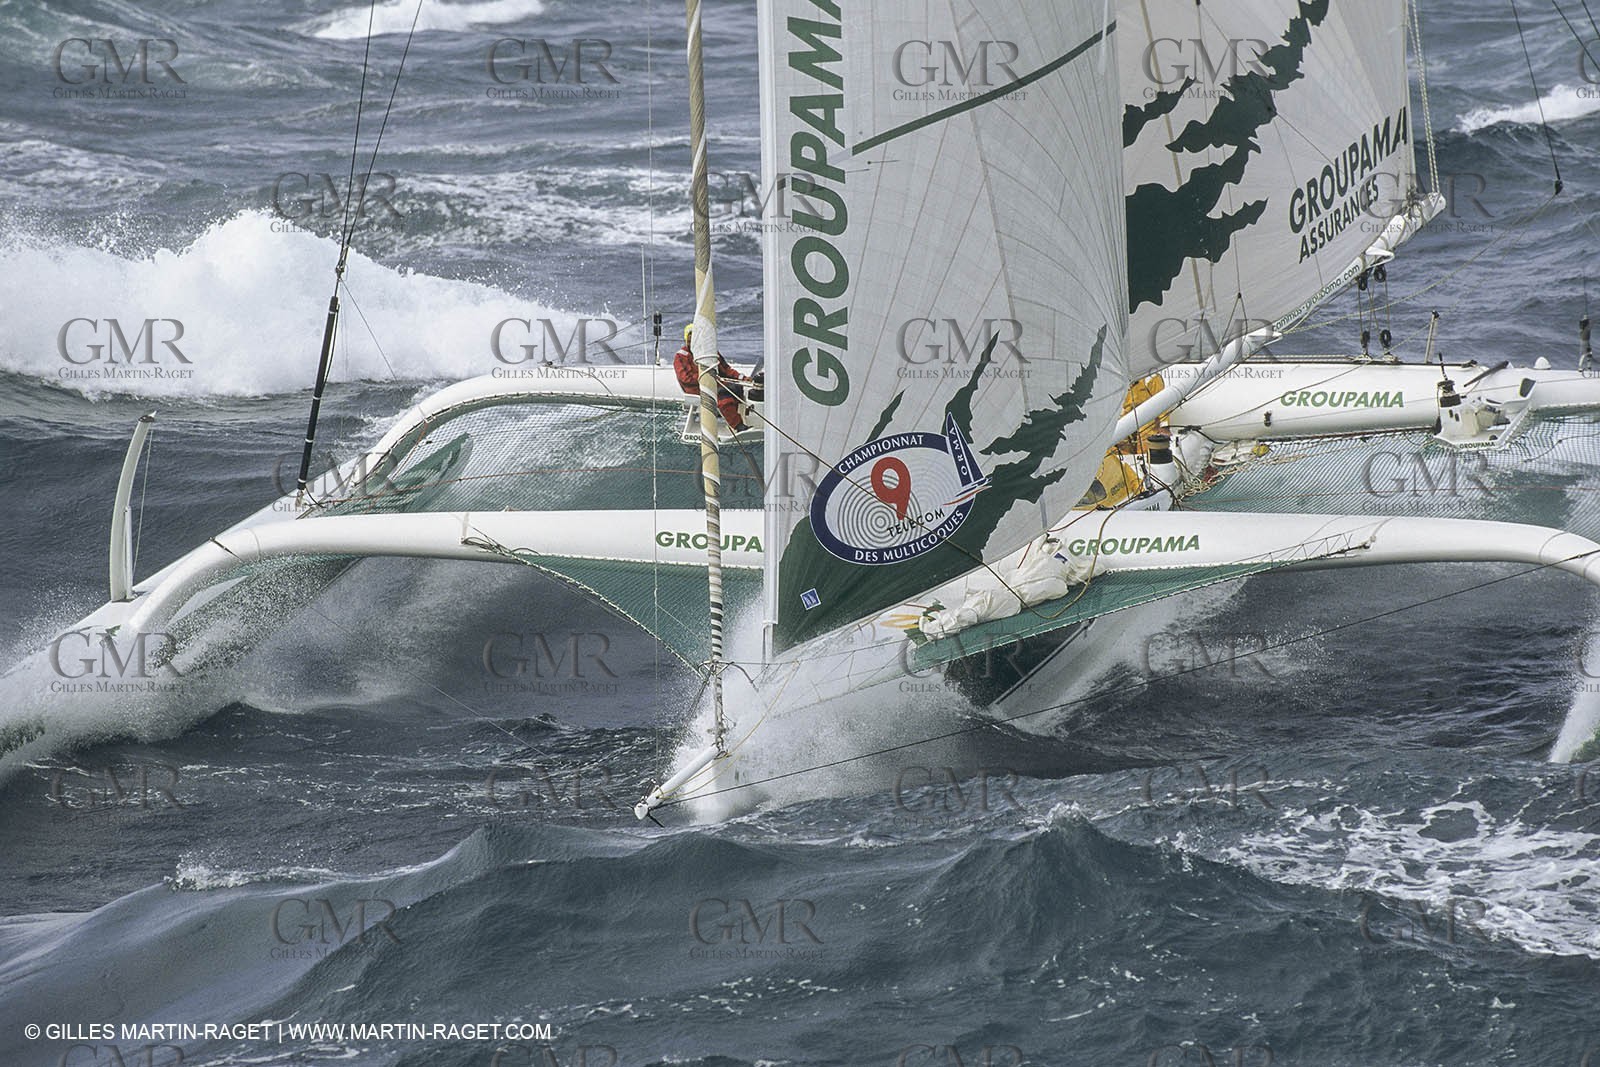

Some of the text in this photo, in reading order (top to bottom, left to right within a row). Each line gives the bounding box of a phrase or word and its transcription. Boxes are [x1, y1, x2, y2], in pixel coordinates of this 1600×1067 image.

[1289, 106, 1408, 234] GROUPAMA
[1299, 173, 1379, 264] ASSURANCES
[1280, 390, 1404, 409] GROUPAMA
[838, 434, 924, 475] CHAMPIONNAT
[949, 427, 969, 477] ORMA
[1459, 441, 1496, 450] GROUPAMA
[855, 509, 965, 562] DES MULTICOQUES
[887, 507, 945, 537] TELECOM
[656, 531, 764, 553] GROUPA
[1068, 534, 1200, 557] GROUPAMA
